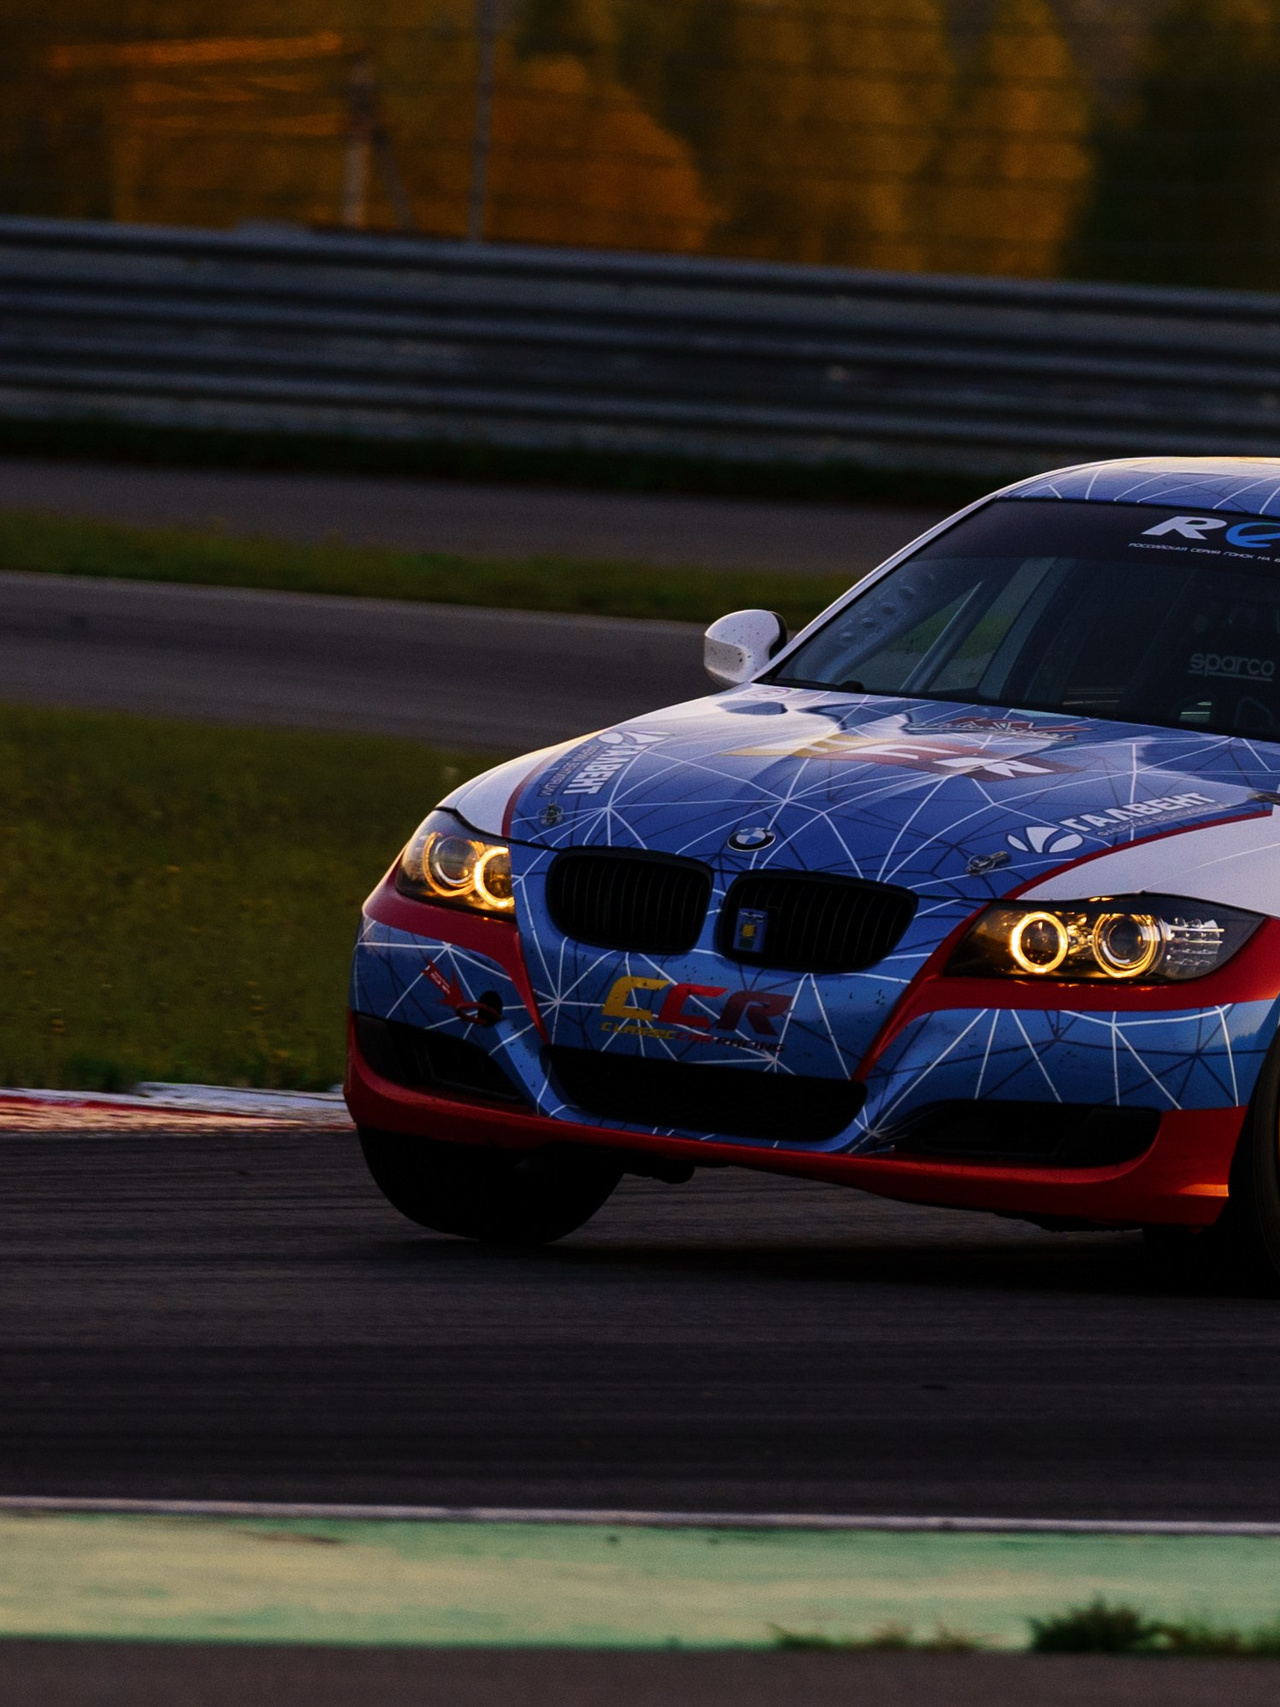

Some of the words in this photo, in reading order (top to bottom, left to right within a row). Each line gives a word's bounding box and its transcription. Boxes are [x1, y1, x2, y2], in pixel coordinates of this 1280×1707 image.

[1128, 542, 1188, 552] РОССИЙСКАЯ
[1190, 547, 1222, 556] СЕРИЯ
[1223, 551, 1255, 560] ГОНОК
[1190, 653, 1275, 677] sparco
[1059, 792, 1215, 832] ГАЛВЕНТ
[601, 975, 794, 1036] CCR
